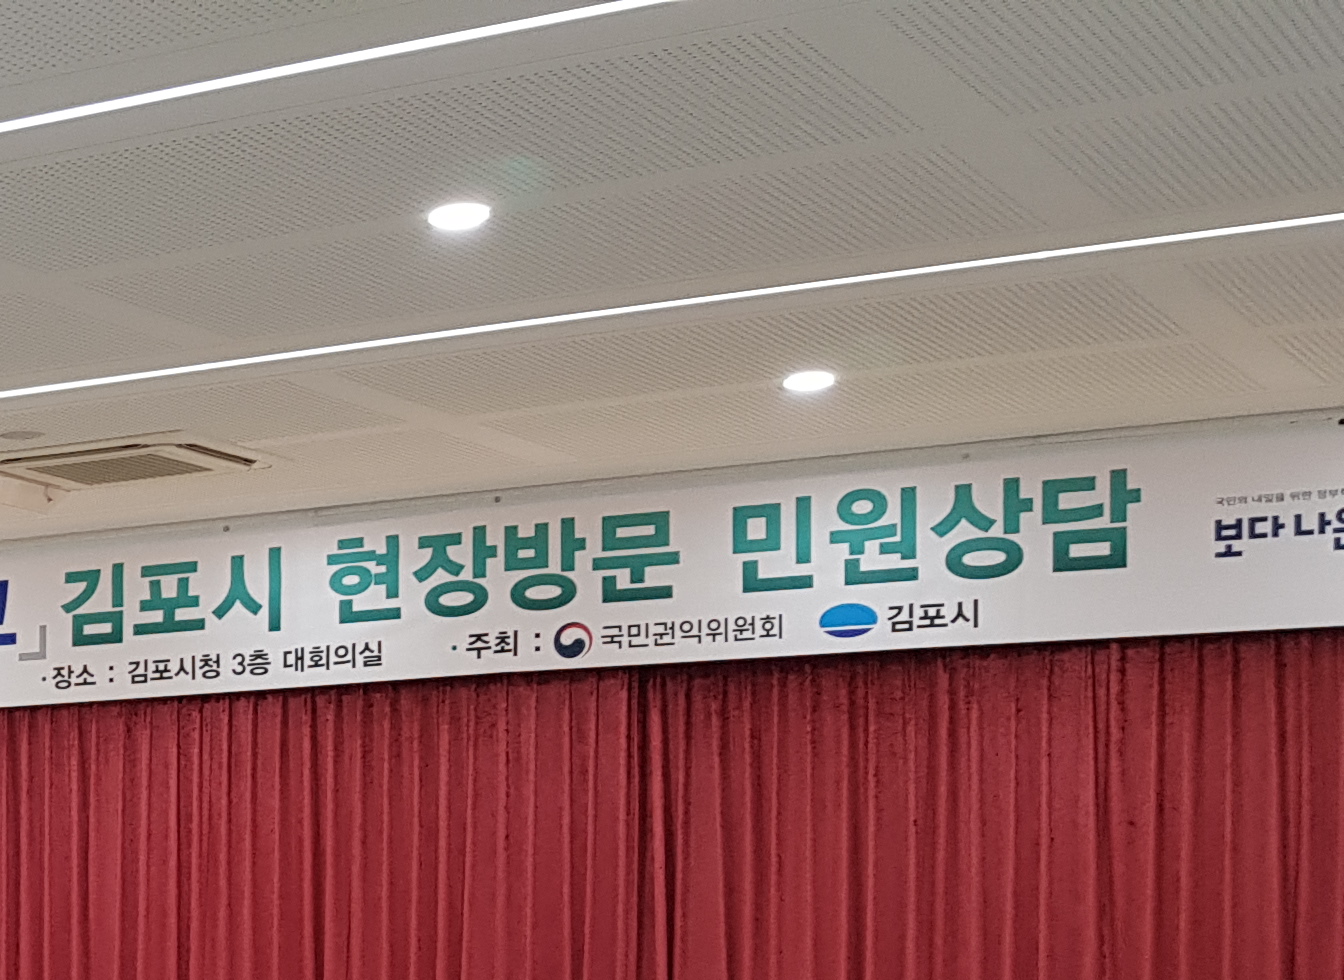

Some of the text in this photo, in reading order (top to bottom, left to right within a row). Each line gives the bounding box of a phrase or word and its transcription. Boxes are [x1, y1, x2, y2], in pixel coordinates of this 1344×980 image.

[1316, 487, 1344, 500] 정부
[1214, 514, 1286, 558] 보다
[60, 546, 282, 648] 김포시
[326, 510, 681, 625] 현장방문
[732, 468, 1142, 594] 민원상담
[600, 613, 784, 650] 국민권익위원회
[886, 598, 979, 633] 김포시
[127, 653, 221, 685] 김포시청
[232, 649, 272, 677] 3층
[282, 640, 384, 673] 대회의실
